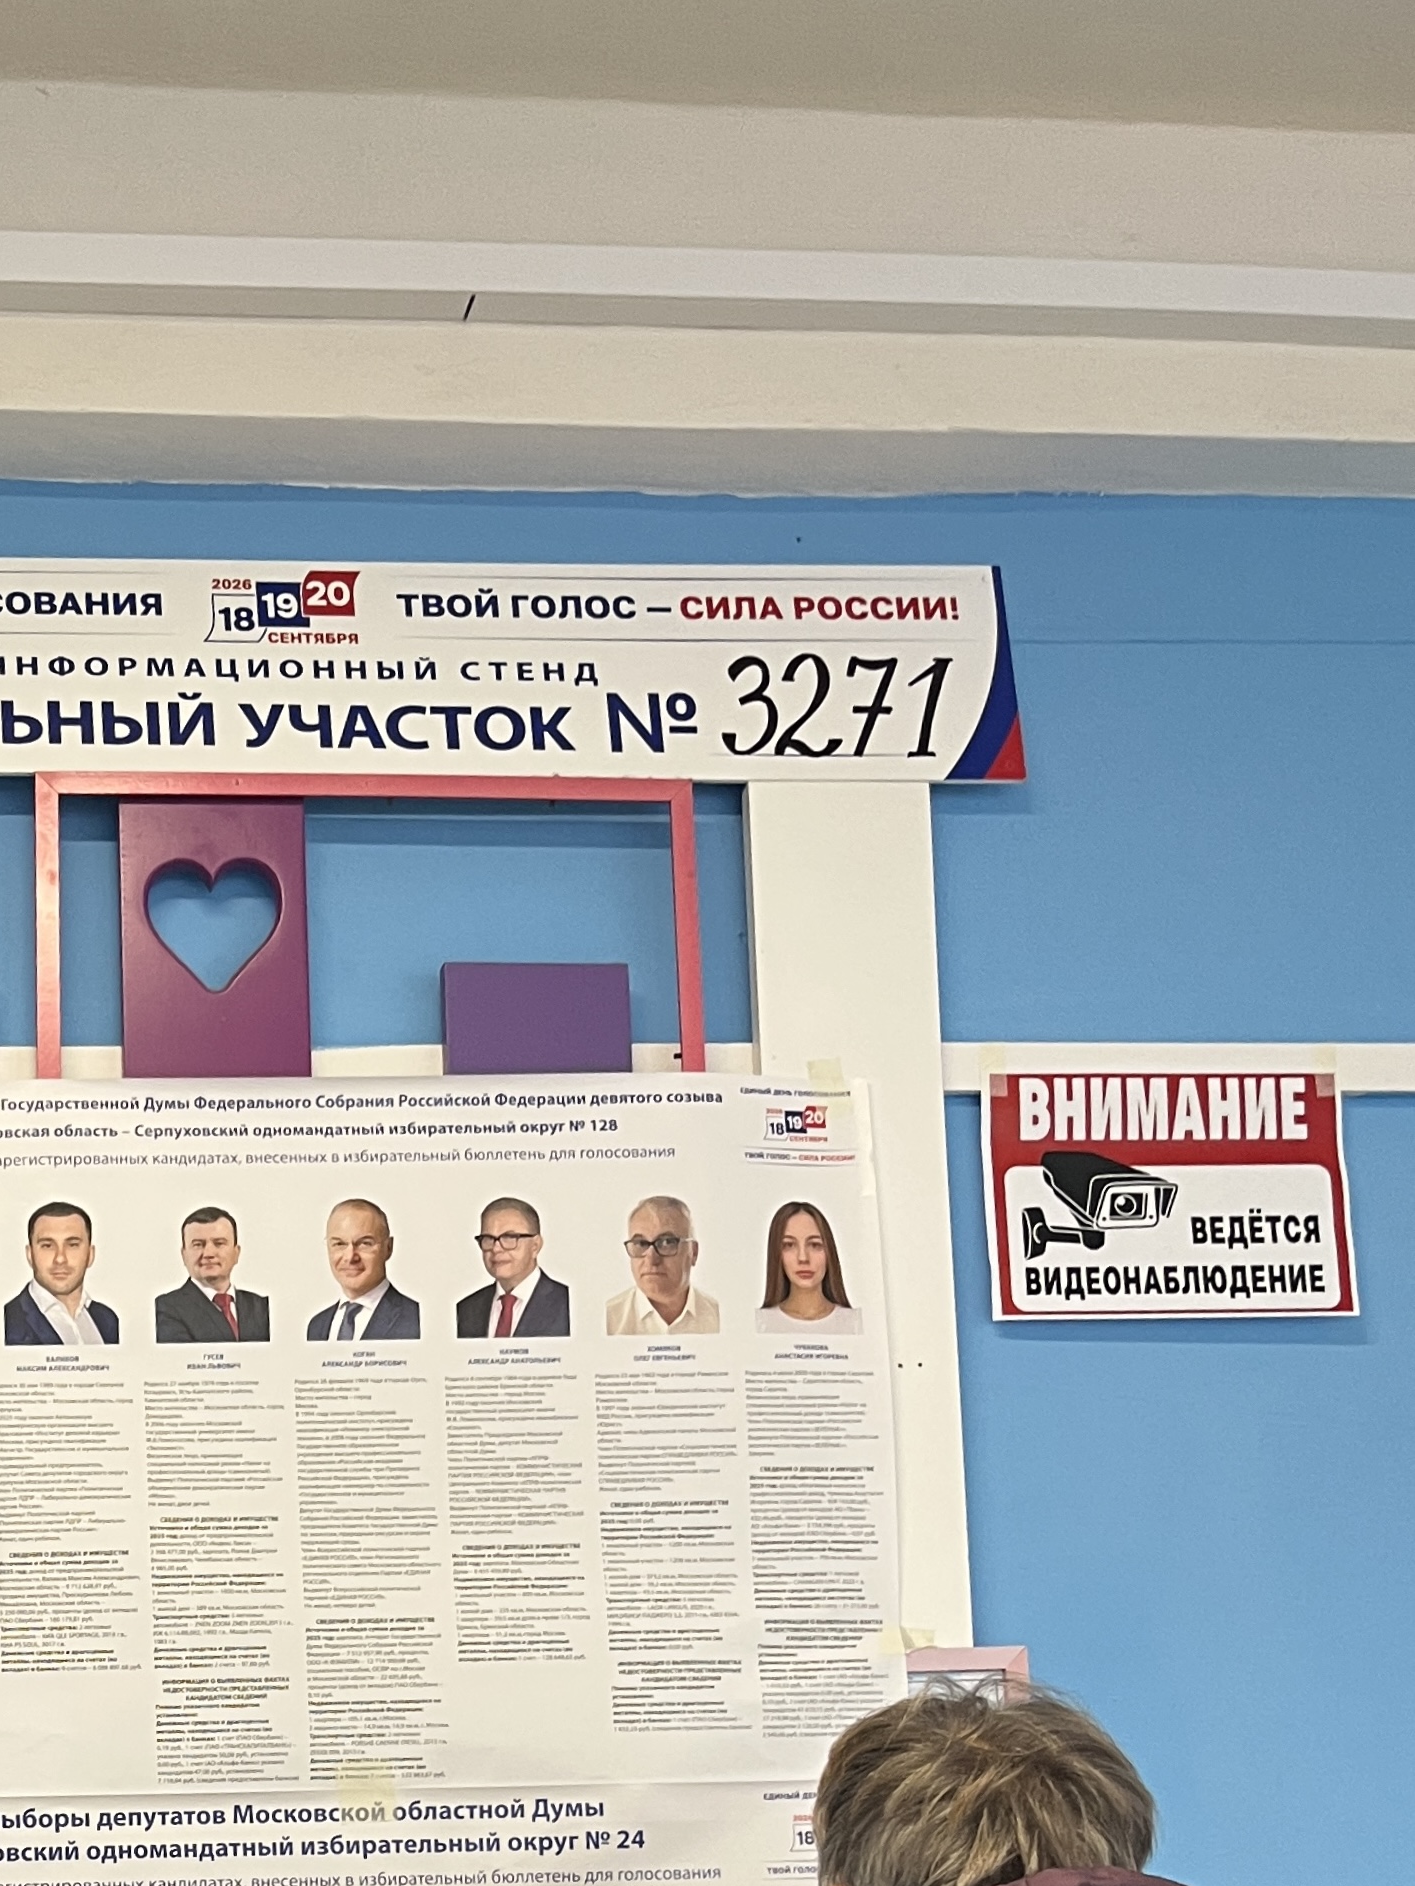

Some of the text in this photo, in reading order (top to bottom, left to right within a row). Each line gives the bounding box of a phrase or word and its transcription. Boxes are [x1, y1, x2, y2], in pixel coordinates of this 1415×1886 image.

[211, 577, 252, 590] 2026
[218, 580, 351, 631] 18 19 20
[396, 590, 958, 619] ТВОЙ ГОЛОС СИЛА РОССИИ!
[264, 630, 359, 644] СЕНТЯБРЯ
[460, 662, 598, 685] СТЕНД
[238, 704, 575, 749] УЧАСТОК
[606, 694, 697, 752] №
[722, 653, 953, 757] 3271
[0, 1096, 140, 1112] Государственной
[142, 1096, 190, 1113] Думы
[193, 1096, 312, 1112] Федерального
[314, 1094, 394, 1111] Собрания
[398, 1092, 491, 1107] Российской
[493, 1092, 586, 1108] Федерации
[588, 1093, 663, 1106] девятого
[665, 1092, 723, 1103] созыва
[1019, 1077, 1307, 1140] ВНИМАНИЕ
[53, 1123, 118, 1137] область
[133, 1123, 249, 1140] Серпуховский
[252, 1122, 385, 1138] одномандатный
[388, 1120, 516, 1137] избирательный
[519, 1122, 566, 1136] округ
[568, 1119, 586, 1132] №
[589, 1118, 618, 1131] 128
[1190, 1209, 1320, 1248] ВЕДЁТСЯ
[1025, 1265, 1325, 1298] ВИДЕОНАБЛЮДЕНИЕ
[96, 1809, 226, 1831] депутатов
[232, 1801, 386, 1824] Московской
[391, 1798, 525, 1821] областной
[532, 1798, 603, 1822] Думы
[86, 1837, 293, 1862] одномандатный
[301, 1833, 499, 1857] избирательный
[507, 1835, 579, 1856] округ
[584, 1830, 611, 1850] №
[615, 1829, 645, 1849] 24
[796, 1830, 815, 1846] 18
[344, 1875, 354, 1886] в
[490, 1868, 581, 1884] бюллетень
[583, 1869, 613, 1885] для
[617, 1867, 721, 1881] голосования
